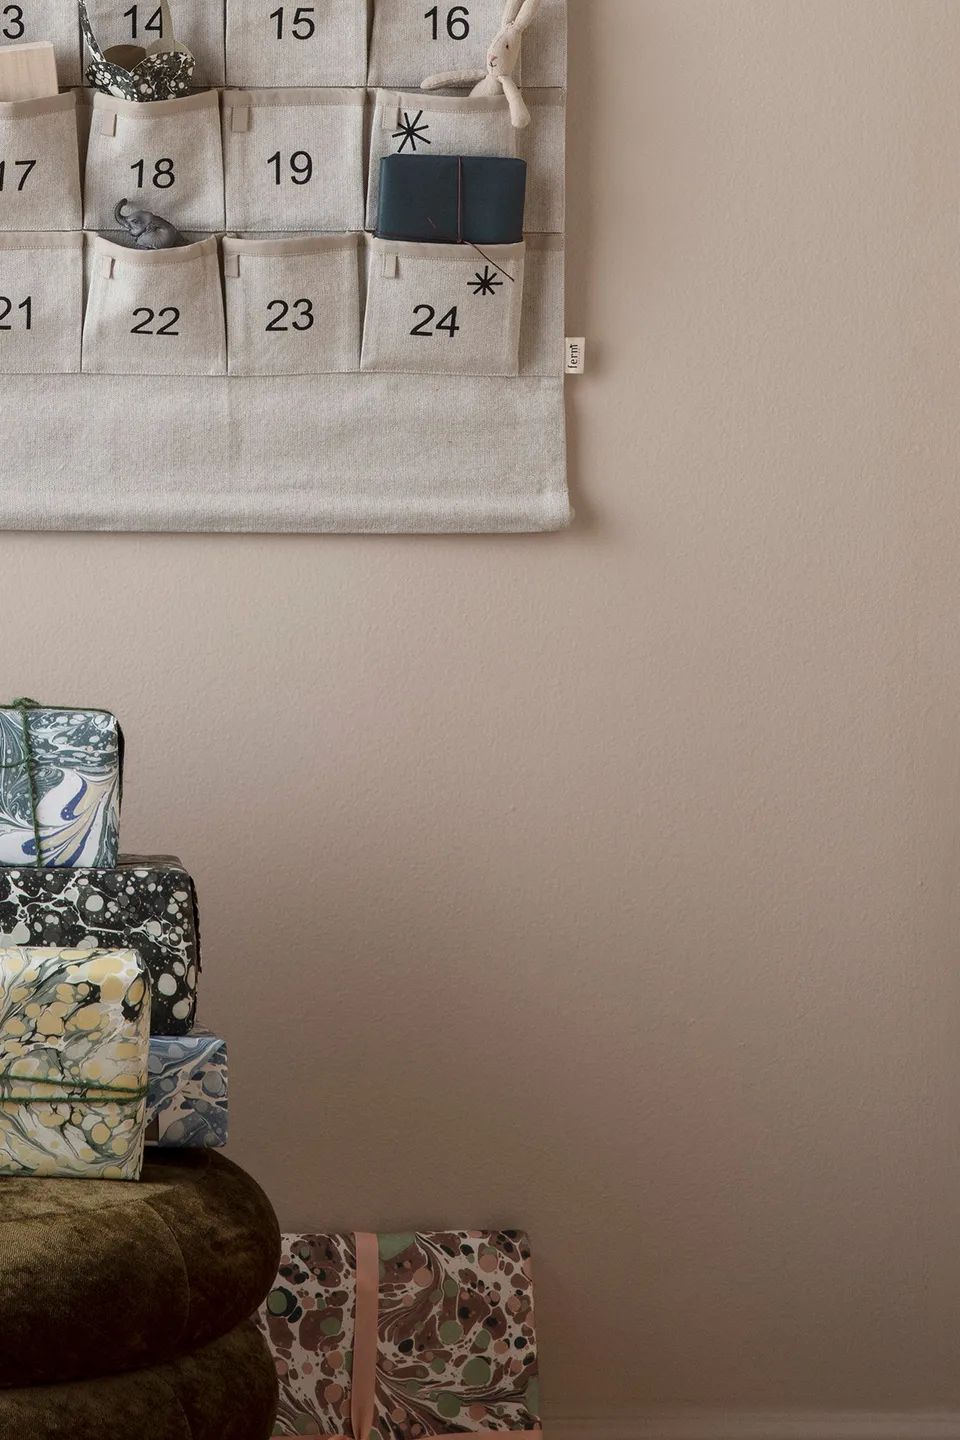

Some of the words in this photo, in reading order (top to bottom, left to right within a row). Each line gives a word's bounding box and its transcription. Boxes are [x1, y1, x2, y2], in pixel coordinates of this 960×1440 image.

[123, 4, 164, 40] 14
[269, 6, 315, 40] 15
[424, 5, 470, 41] 16
[130, 157, 176, 189] 18
[267, 150, 313, 185] 19
[130, 306, 180, 336] 22
[265, 298, 314, 332] 23
[409, 304, 460, 338] 24
[567, 343, 579, 369] ferm
